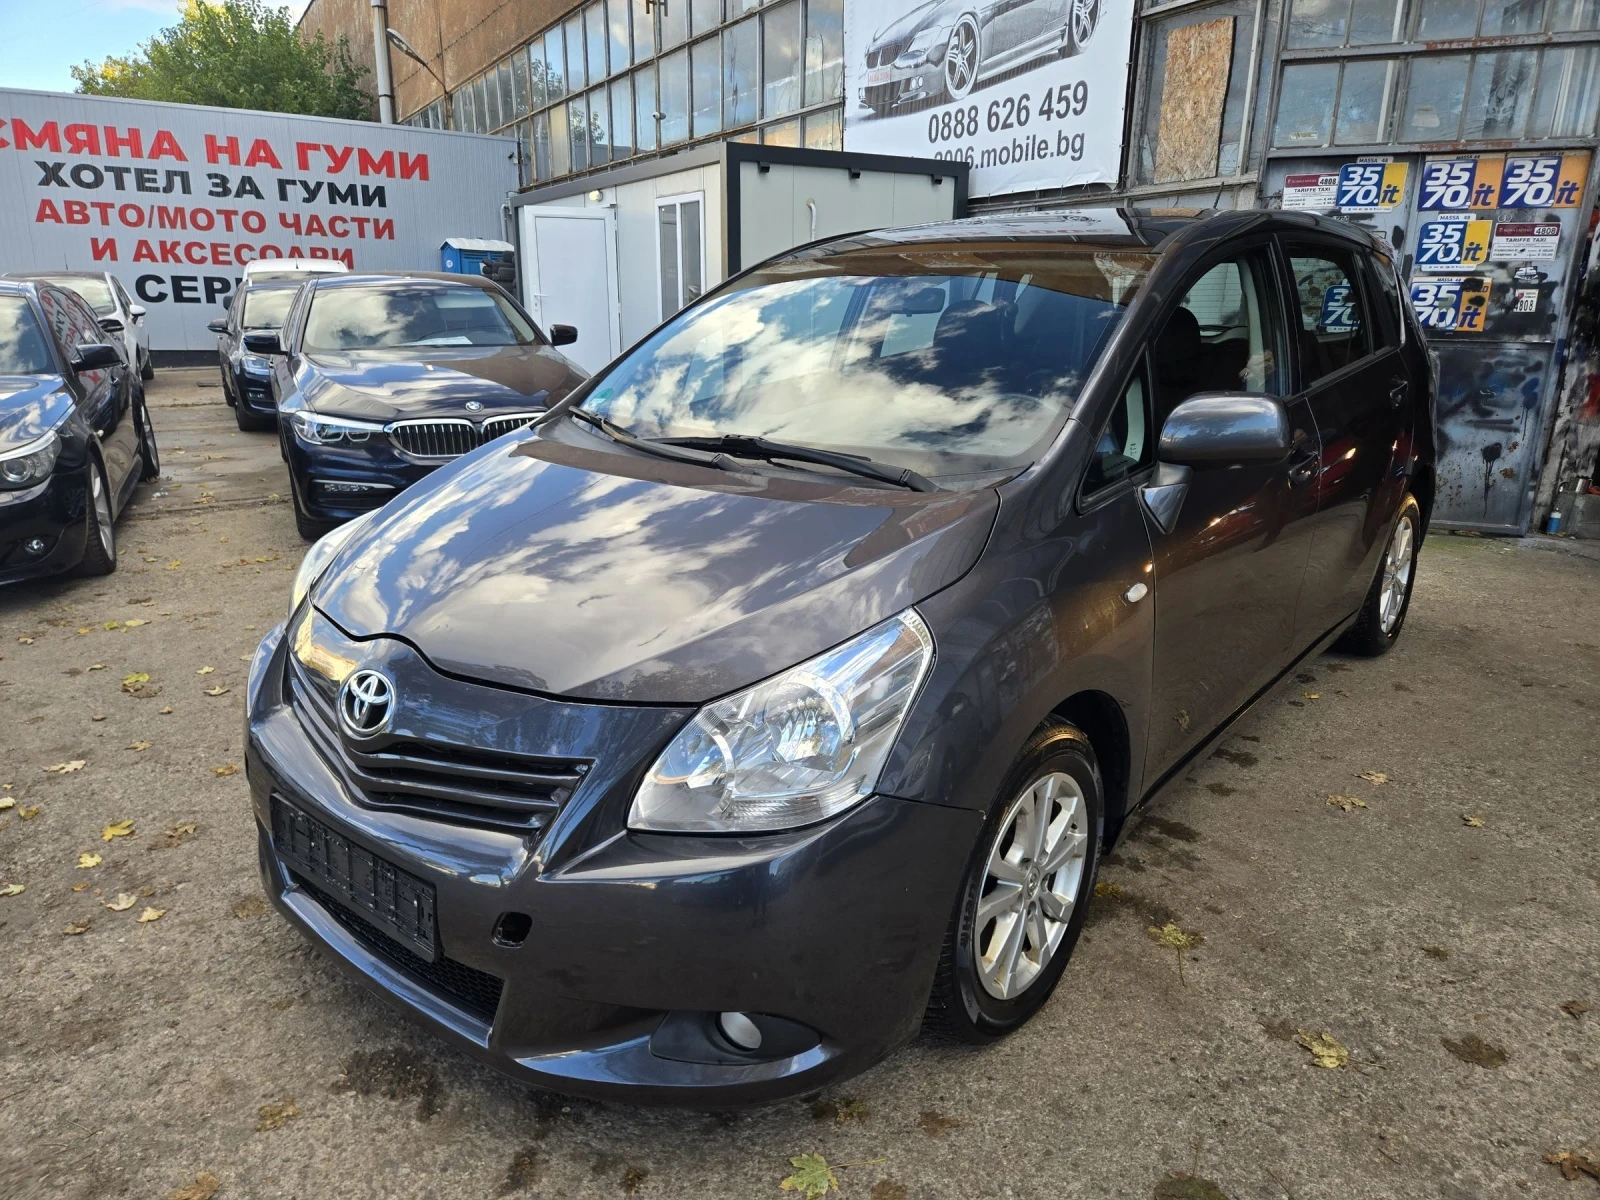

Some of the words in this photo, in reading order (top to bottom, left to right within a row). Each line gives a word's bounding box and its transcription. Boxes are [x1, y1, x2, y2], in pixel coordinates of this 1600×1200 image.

[928, 104, 979, 144] 0888
[987, 92, 1031, 133] 626
[1038, 79, 1088, 123] 459
[204, 133, 284, 171] НА
[295, 140, 430, 182] ГУМИ
[1319, 177, 1337, 185] 4808
[1342, 166, 1382, 186] 35
[1425, 162, 1474, 186] 35
[1506, 159, 1559, 183] 35
[34, 160, 192, 195] ХОТЕЛ
[206, 172, 265, 201] ЗА
[276, 179, 388, 208] ГУМИ
[35, 198, 267, 234] АВТО/МОТО
[278, 212, 395, 240] ЧАСТИ
[1536, 227, 1556, 235] 4808
[1422, 223, 1465, 244] 35
[90, 237, 119, 262] И
[132, 239, 355, 270] АКСЕСОАРИ
[135, 273, 243, 305] СЕР
[1413, 284, 1461, 307] 35
